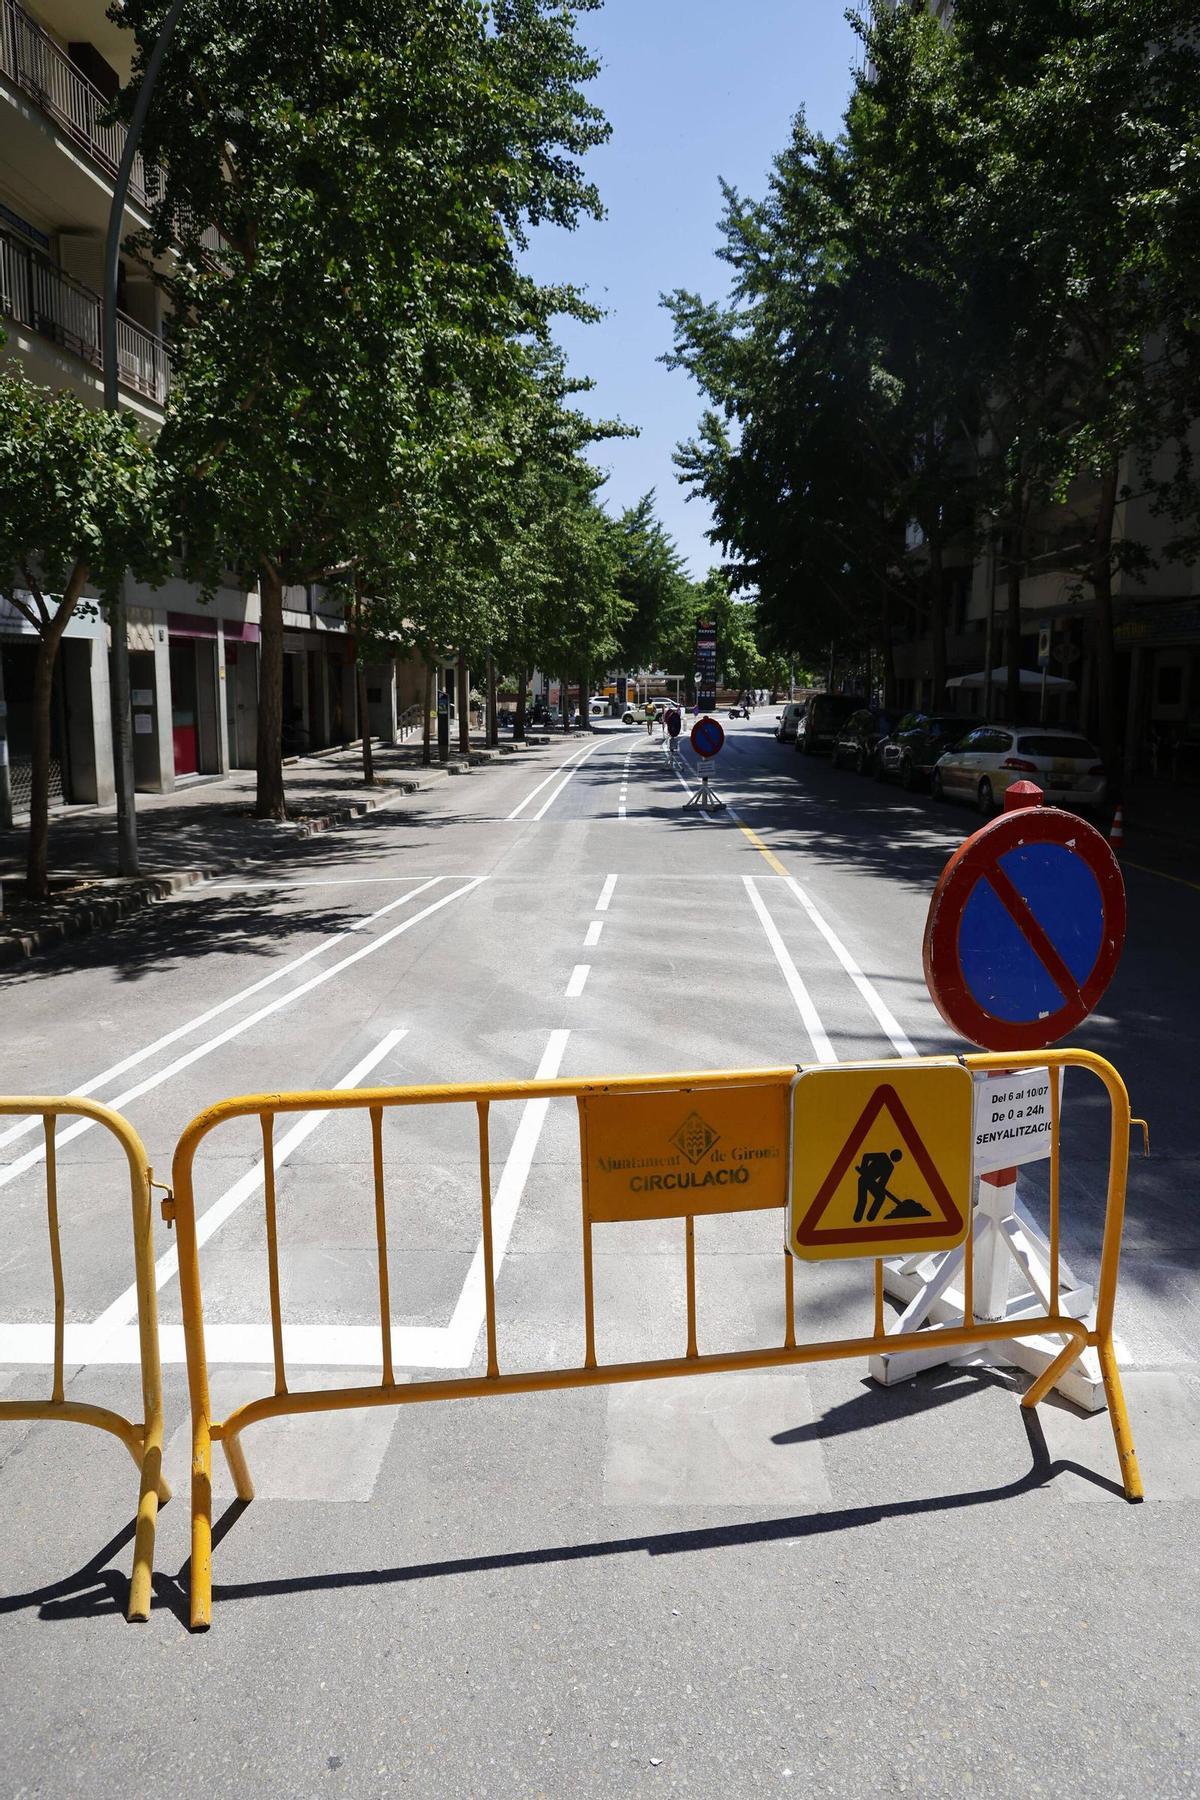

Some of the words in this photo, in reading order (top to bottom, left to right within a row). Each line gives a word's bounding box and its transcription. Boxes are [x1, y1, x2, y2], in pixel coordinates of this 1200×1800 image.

[991, 1093, 1007, 1104] Del
[1008, 1092, 1014, 1101] 6
[1015, 1090, 1024, 1100] al
[1026, 1086, 1049, 1098] 10/07
[991, 1112, 1005, 1123] De
[1008, 1109, 1014, 1120] 0
[1016, 1110, 1024, 1118] a
[1026, 1105, 1044, 1117] 24h
[597, 1155, 680, 1173] Ajuntament
[710, 1149, 726, 1163] de
[629, 1165, 750, 1193] CIRCULACIÓ
